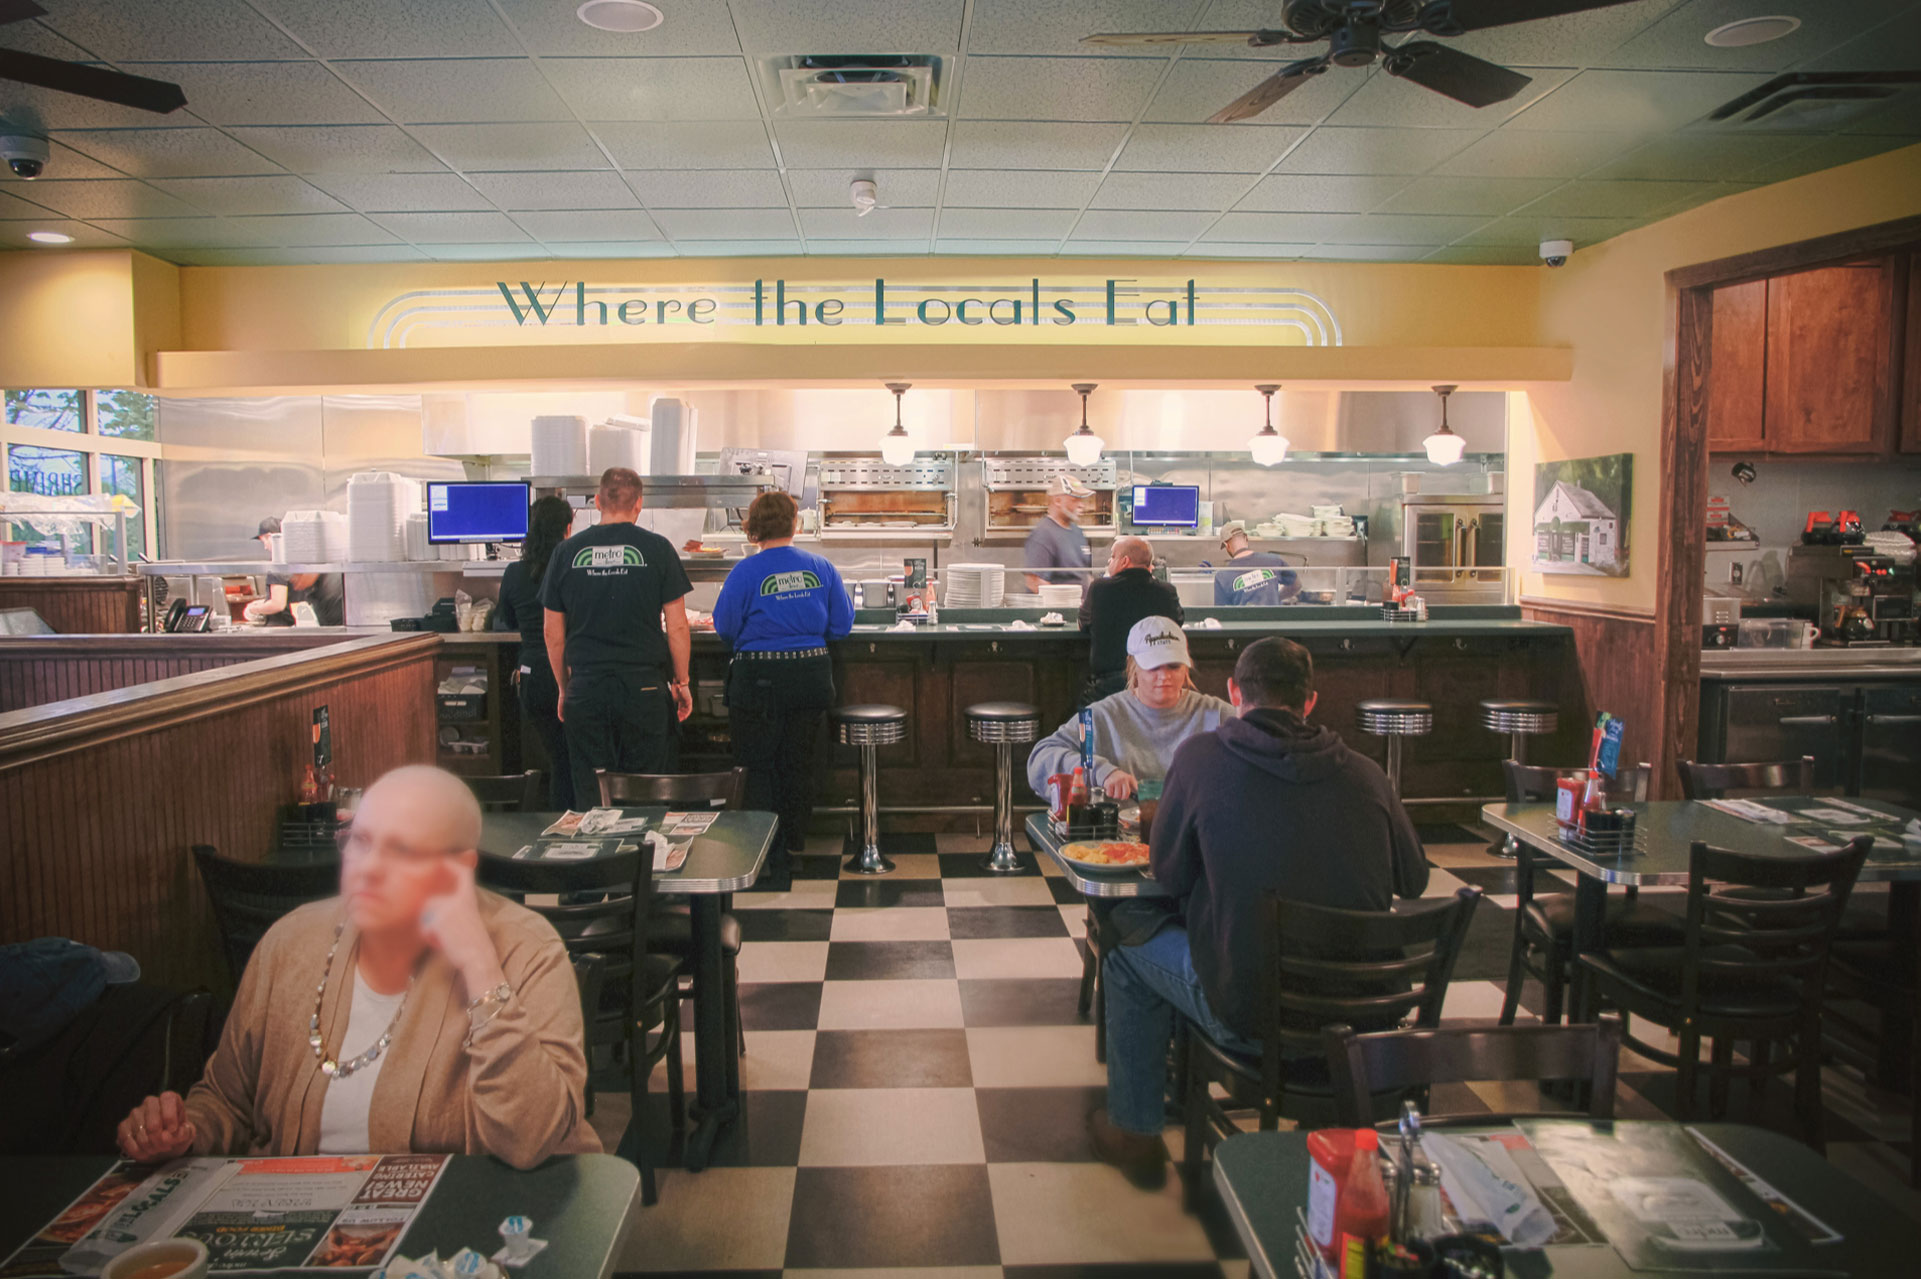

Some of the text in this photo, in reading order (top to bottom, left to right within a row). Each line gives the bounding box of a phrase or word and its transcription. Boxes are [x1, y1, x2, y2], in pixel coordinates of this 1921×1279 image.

[496, 278, 1200, 326] Where the Locals Eat
[594, 548, 622, 560] metro
[778, 574, 802, 586] metro
[372, 1170, 435, 1180] CATERING
[365, 1180, 428, 1190] NEWS!
[360, 1188, 422, 1200] GREAT
